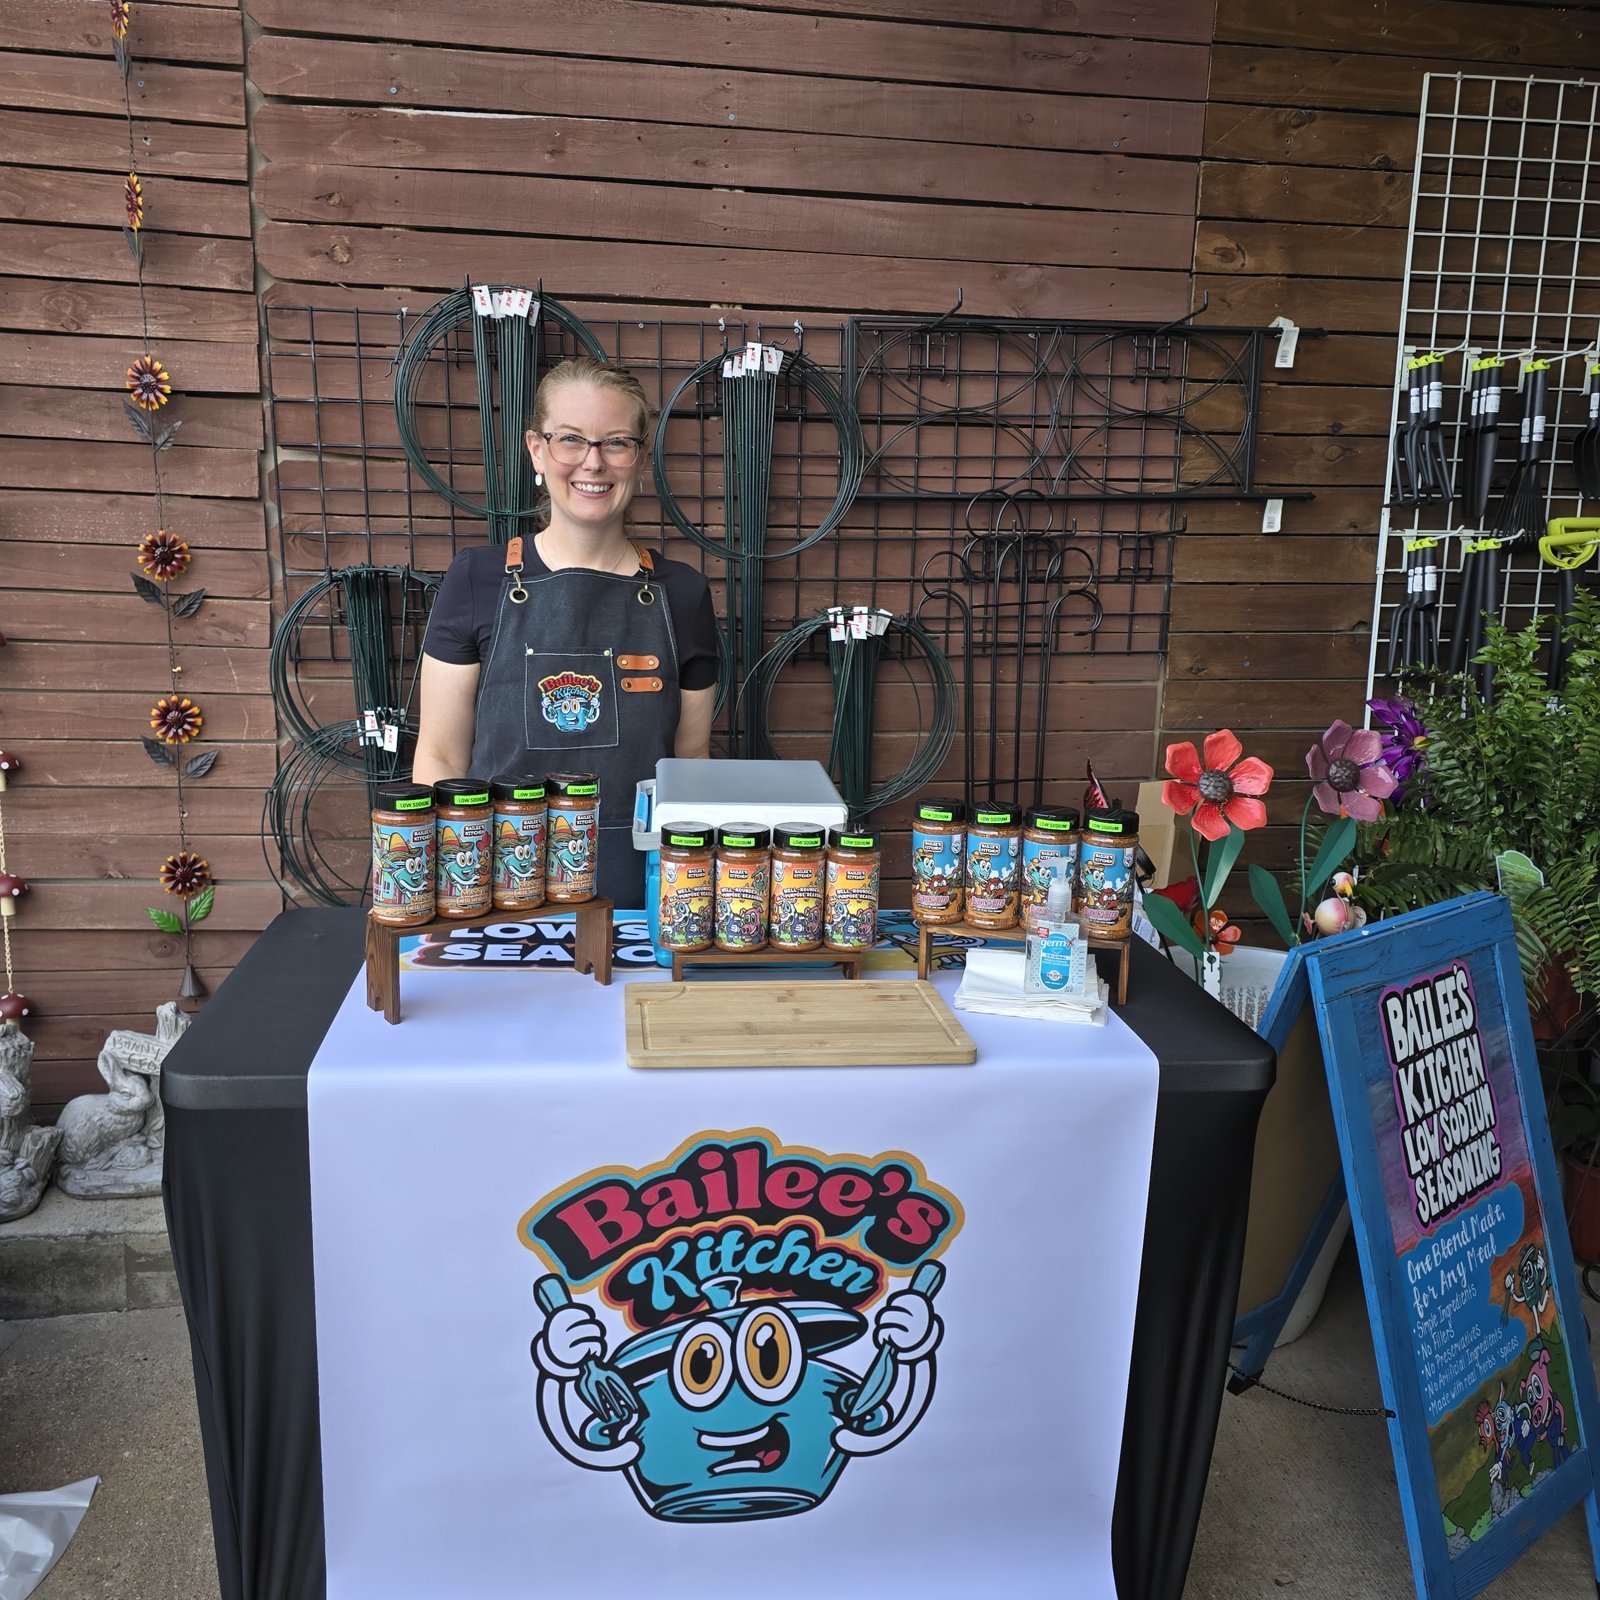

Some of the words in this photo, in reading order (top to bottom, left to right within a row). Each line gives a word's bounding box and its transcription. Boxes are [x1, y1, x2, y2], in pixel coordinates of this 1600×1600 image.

[544, 674, 599, 690] Bailee's
[554, 686, 590, 698] Kitchen
[1398, 1033, 1486, 1126] KITCHEN
[1404, 1113, 1441, 1176] LOW
[1440, 1083, 1496, 1152] SODIUM
[556, 1148, 944, 1261] Bailee's
[1416, 1130, 1501, 1224] SEASONING
[627, 1229, 874, 1311] Kitchen
[1407, 1253, 1433, 1285] One
[1432, 1220, 1472, 1268] Blend
[1413, 1286, 1438, 1319] for
[1440, 1261, 1468, 1296] Any
[1467, 1232, 1496, 1272] Meal
[1417, 1313, 1438, 1338] Simple
[1437, 1283, 1477, 1327] Ingredients
[1421, 1344, 1432, 1360] No
[1432, 1329, 1455, 1350] Fillers
[1424, 1362, 1436, 1380] No
[1434, 1324, 1481, 1369] Preservatives
[1428, 1381, 1439, 1398] No
[1438, 1354, 1466, 1390] Artificial
[1466, 1328, 1502, 1368] Ingredients
[1430, 1392, 1450, 1416] Made
[1450, 1379, 1464, 1399] with
[1464, 1368, 1478, 1388] real
[1478, 1355, 1496, 1376] herbs
[1500, 1336, 1518, 1363] spices
